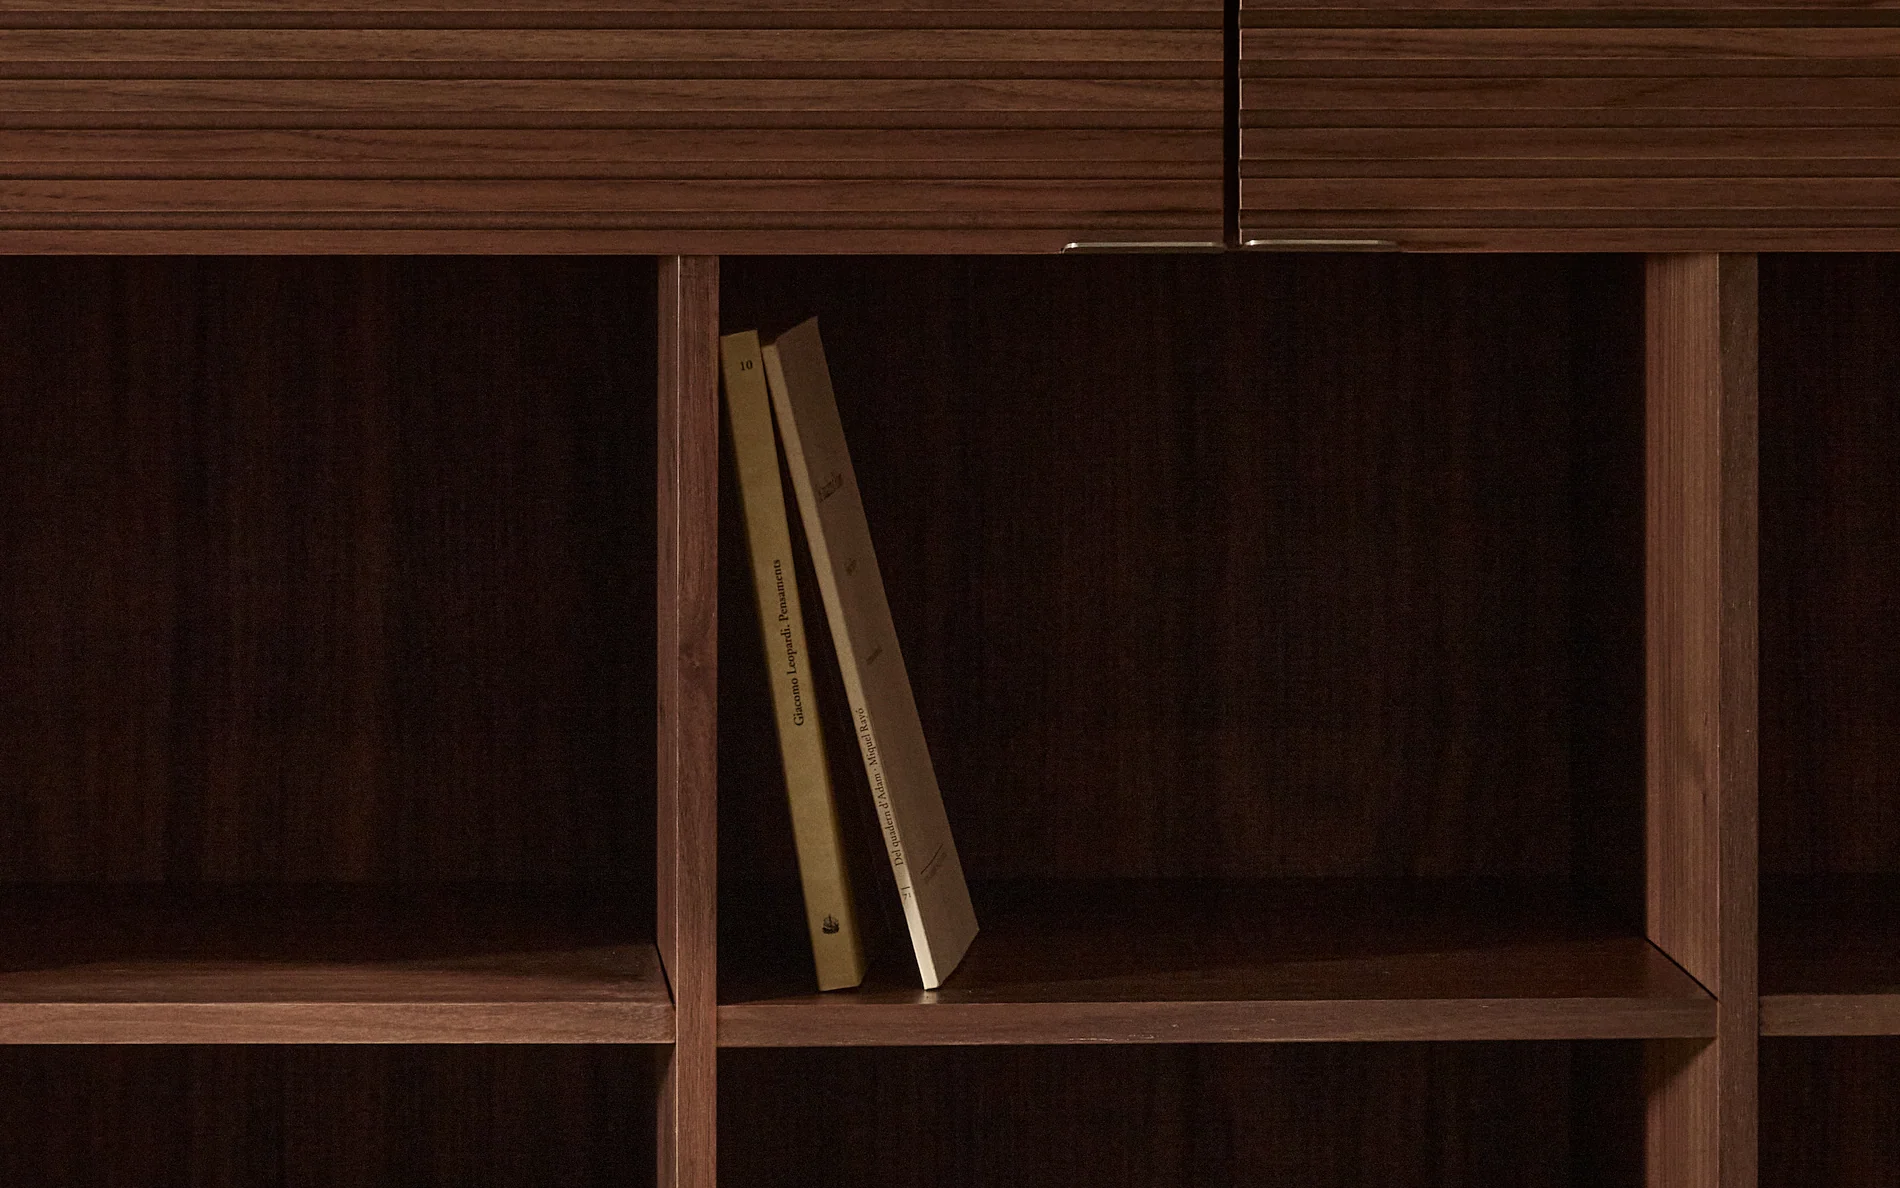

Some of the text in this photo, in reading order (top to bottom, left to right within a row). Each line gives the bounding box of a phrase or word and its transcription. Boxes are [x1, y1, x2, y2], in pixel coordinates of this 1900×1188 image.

[739, 360, 753, 371] 10
[774, 559, 805, 727] Giacomo Leopardi. Pensaments
[856, 707, 869, 732] Rayó
[861, 734, 878, 766] Miquel
[885, 811, 901, 848] quadern
[891, 846, 904, 867] Del
